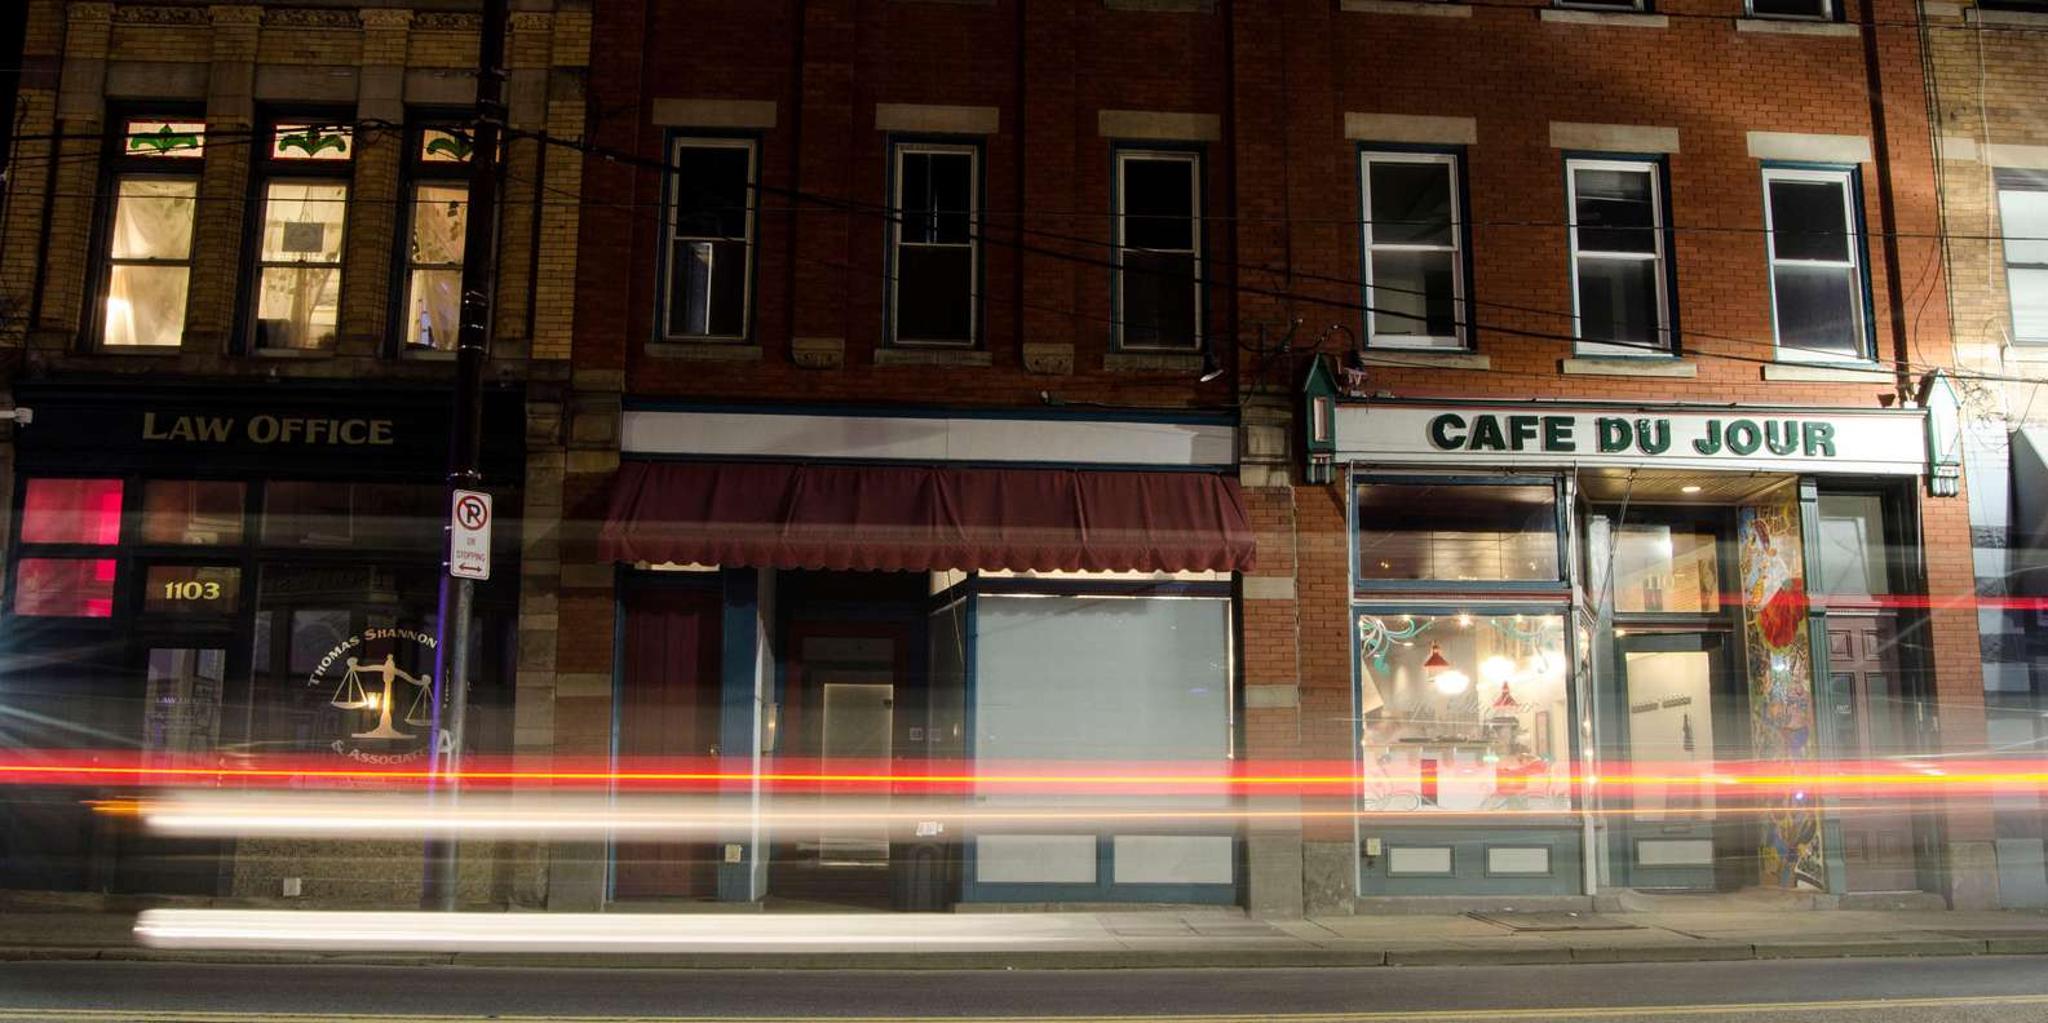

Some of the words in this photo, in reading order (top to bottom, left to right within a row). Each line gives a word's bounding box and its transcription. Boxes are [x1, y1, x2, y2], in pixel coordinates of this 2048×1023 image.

[143, 412, 234, 442] LAW
[248, 415, 394, 444] OFFICE
[1428, 413, 1576, 452] CAFE
[1596, 417, 1672, 456] DU
[1693, 418, 1836, 457] JOUR
[165, 581, 220, 600] 1103
[308, 635, 361, 688] THOMAS
[364, 628, 438, 649] SHANNON
[346, 748, 427, 765] ASSOCIAT
